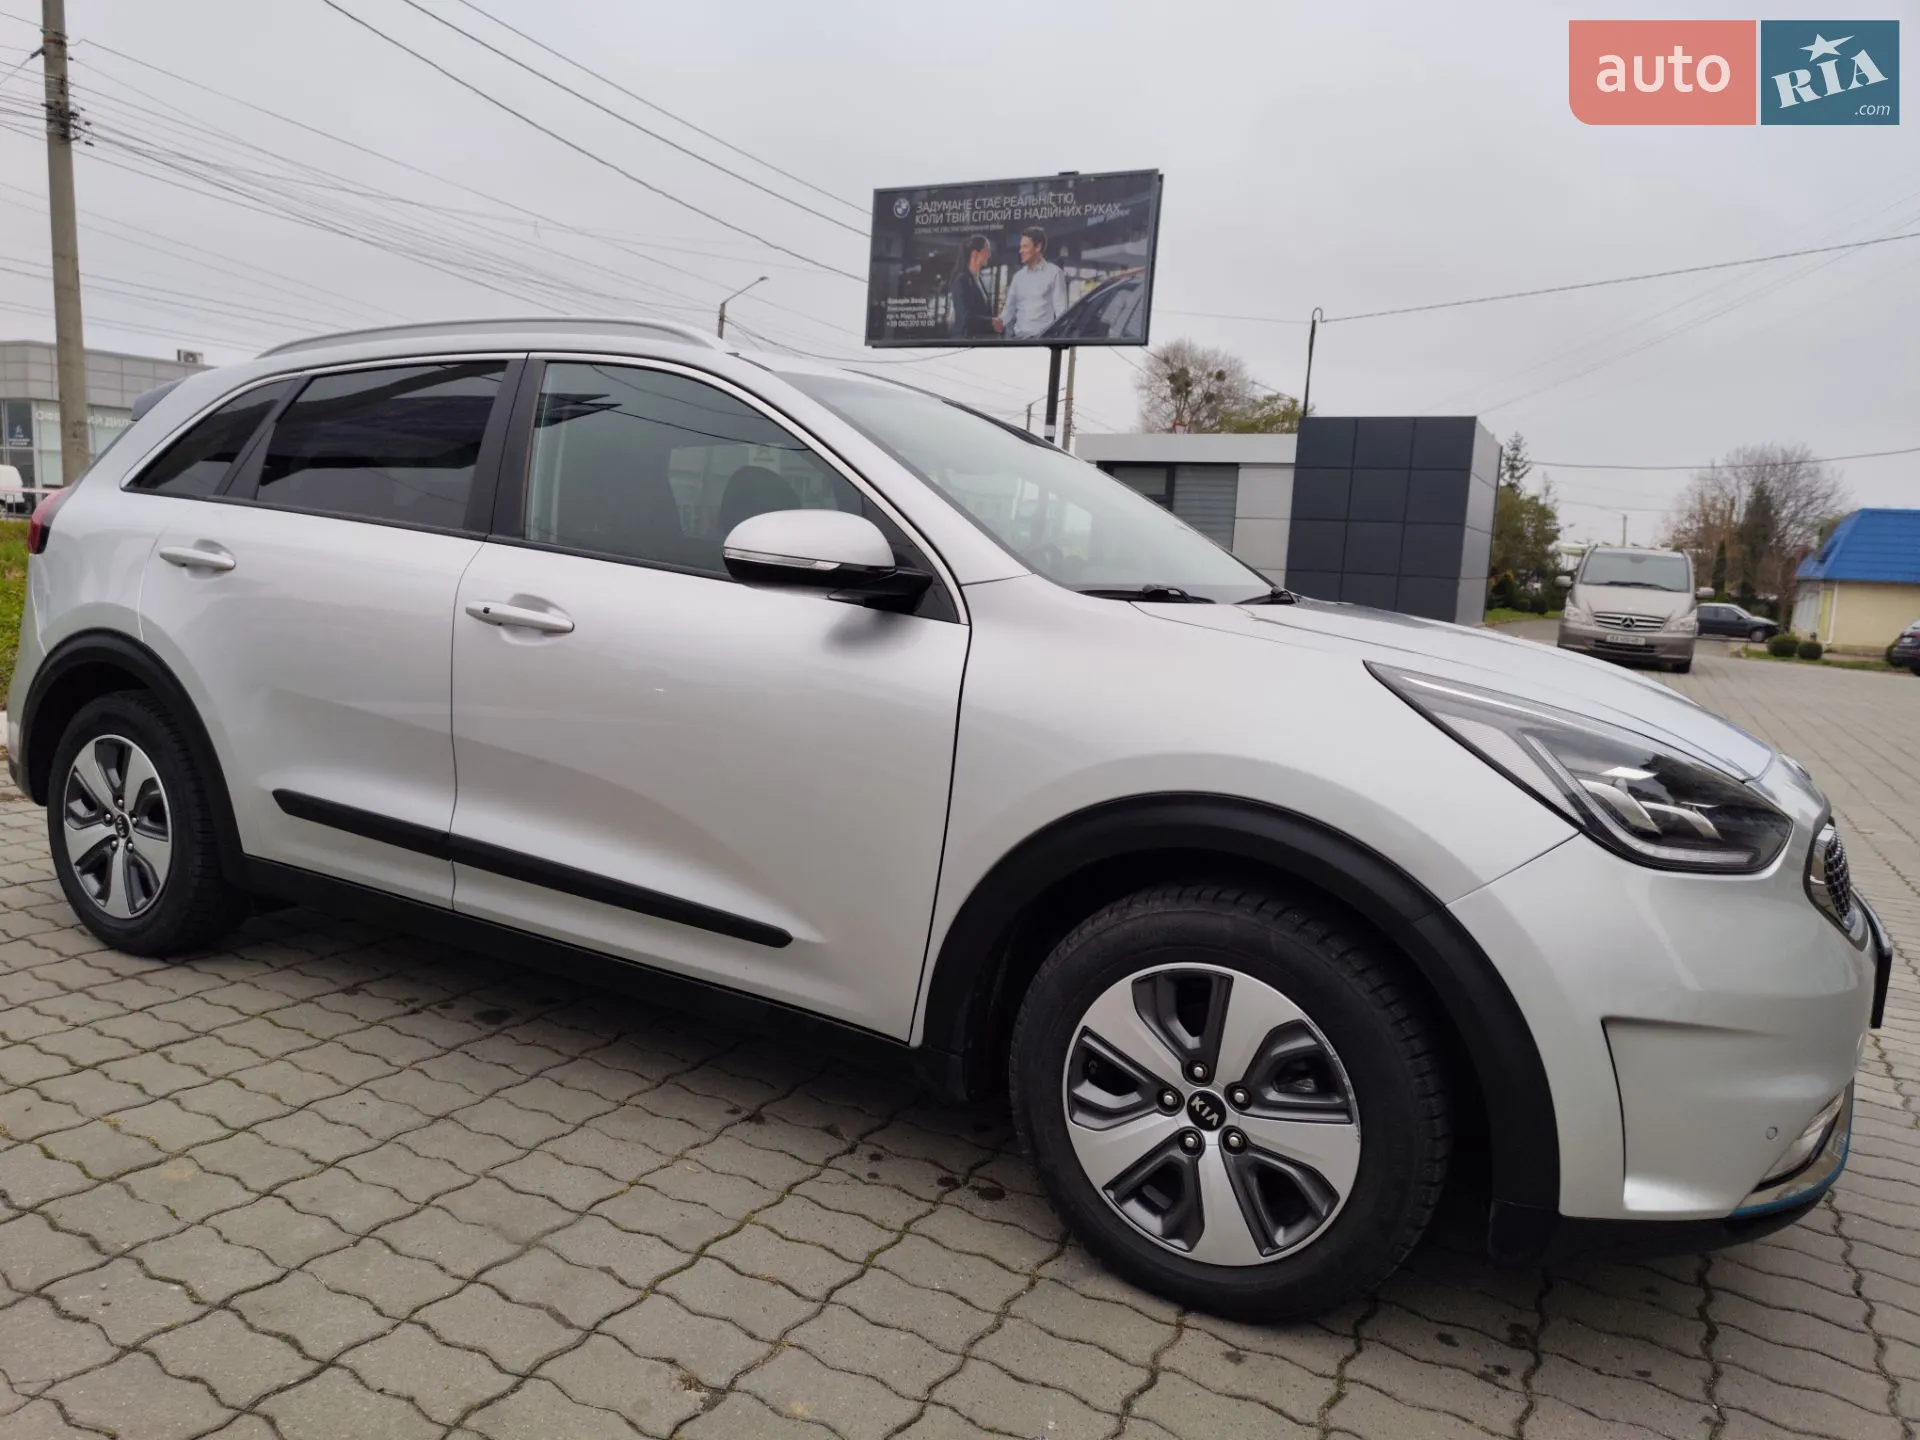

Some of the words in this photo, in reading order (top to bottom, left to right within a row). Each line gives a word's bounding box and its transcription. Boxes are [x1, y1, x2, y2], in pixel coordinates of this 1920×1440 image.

[915, 212, 944, 226] КОЛИ
[945, 209, 971, 223] ТВІЙ
[972, 207, 1011, 222] СПОКІЙ
[1013, 208, 1022, 220] В
[1023, 203, 1082, 220] НАДІЙНИХ
[1084, 200, 1121, 216] РУКАХ
[916, 198, 973, 214] ЗАДУМАНЕ
[974, 196, 1002, 210] СТАЄ
[1003, 191, 1077, 207] РЕАЛЬНІСТЮ,
[1190, 1096, 1220, 1127] KIA
